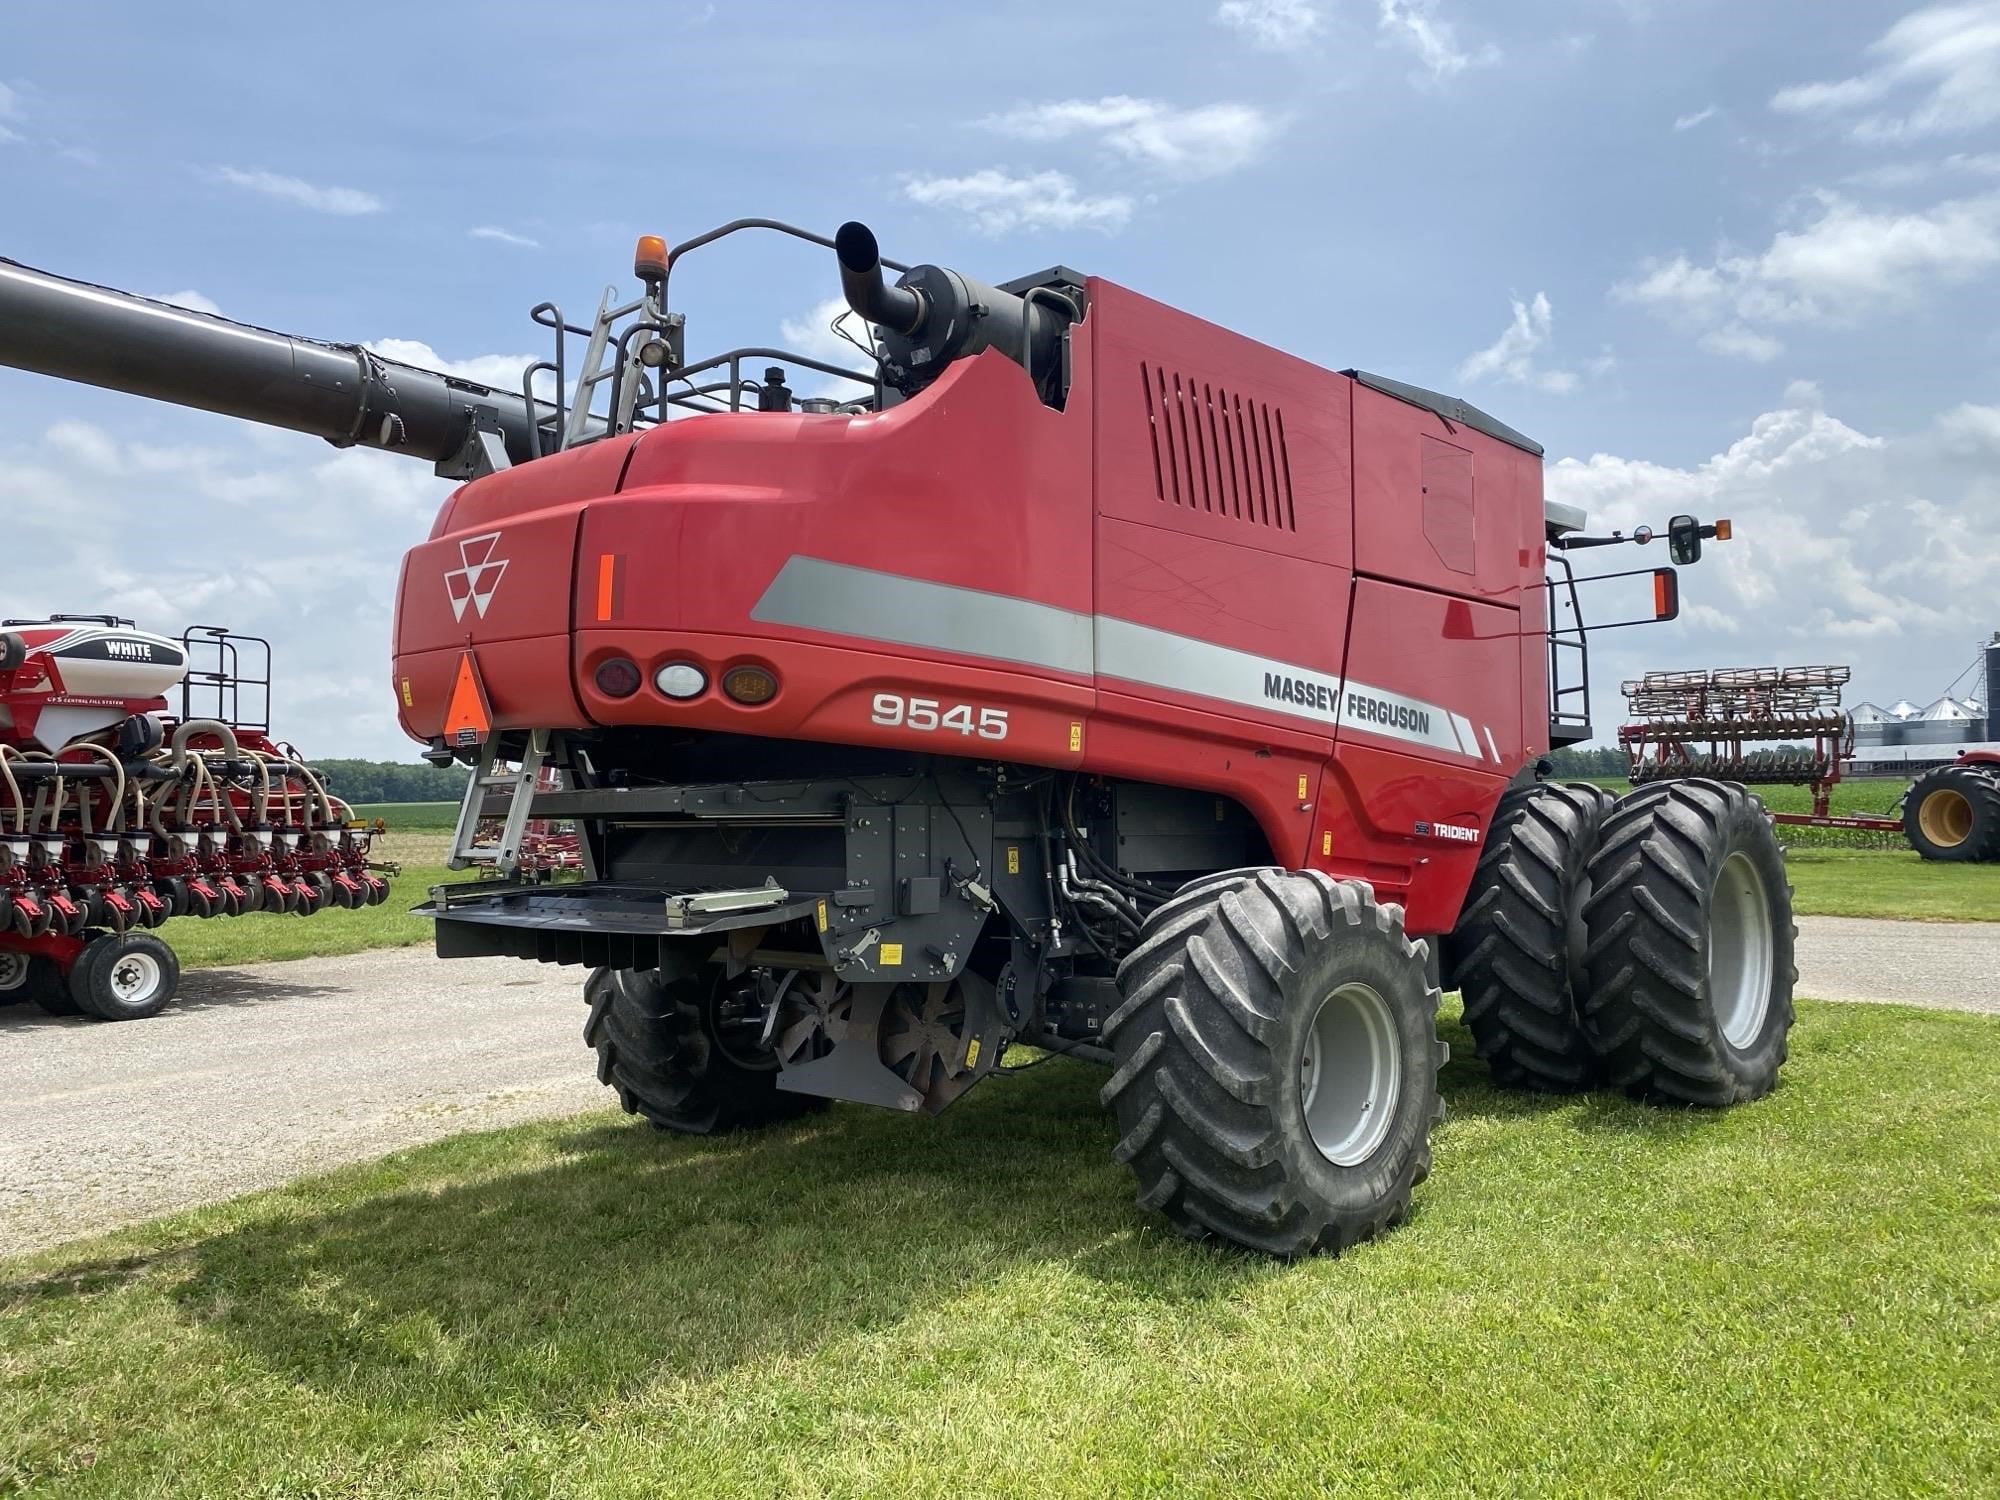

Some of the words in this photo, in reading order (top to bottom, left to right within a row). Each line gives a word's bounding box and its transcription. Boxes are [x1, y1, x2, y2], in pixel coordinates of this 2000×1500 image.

[105, 641, 151, 657] WHITE
[871, 693, 1008, 740] 9545
[1264, 672, 1338, 712] MASSEY
[1347, 693, 1429, 734] FERGUSON
[1433, 823, 1479, 842] TRIDENT
